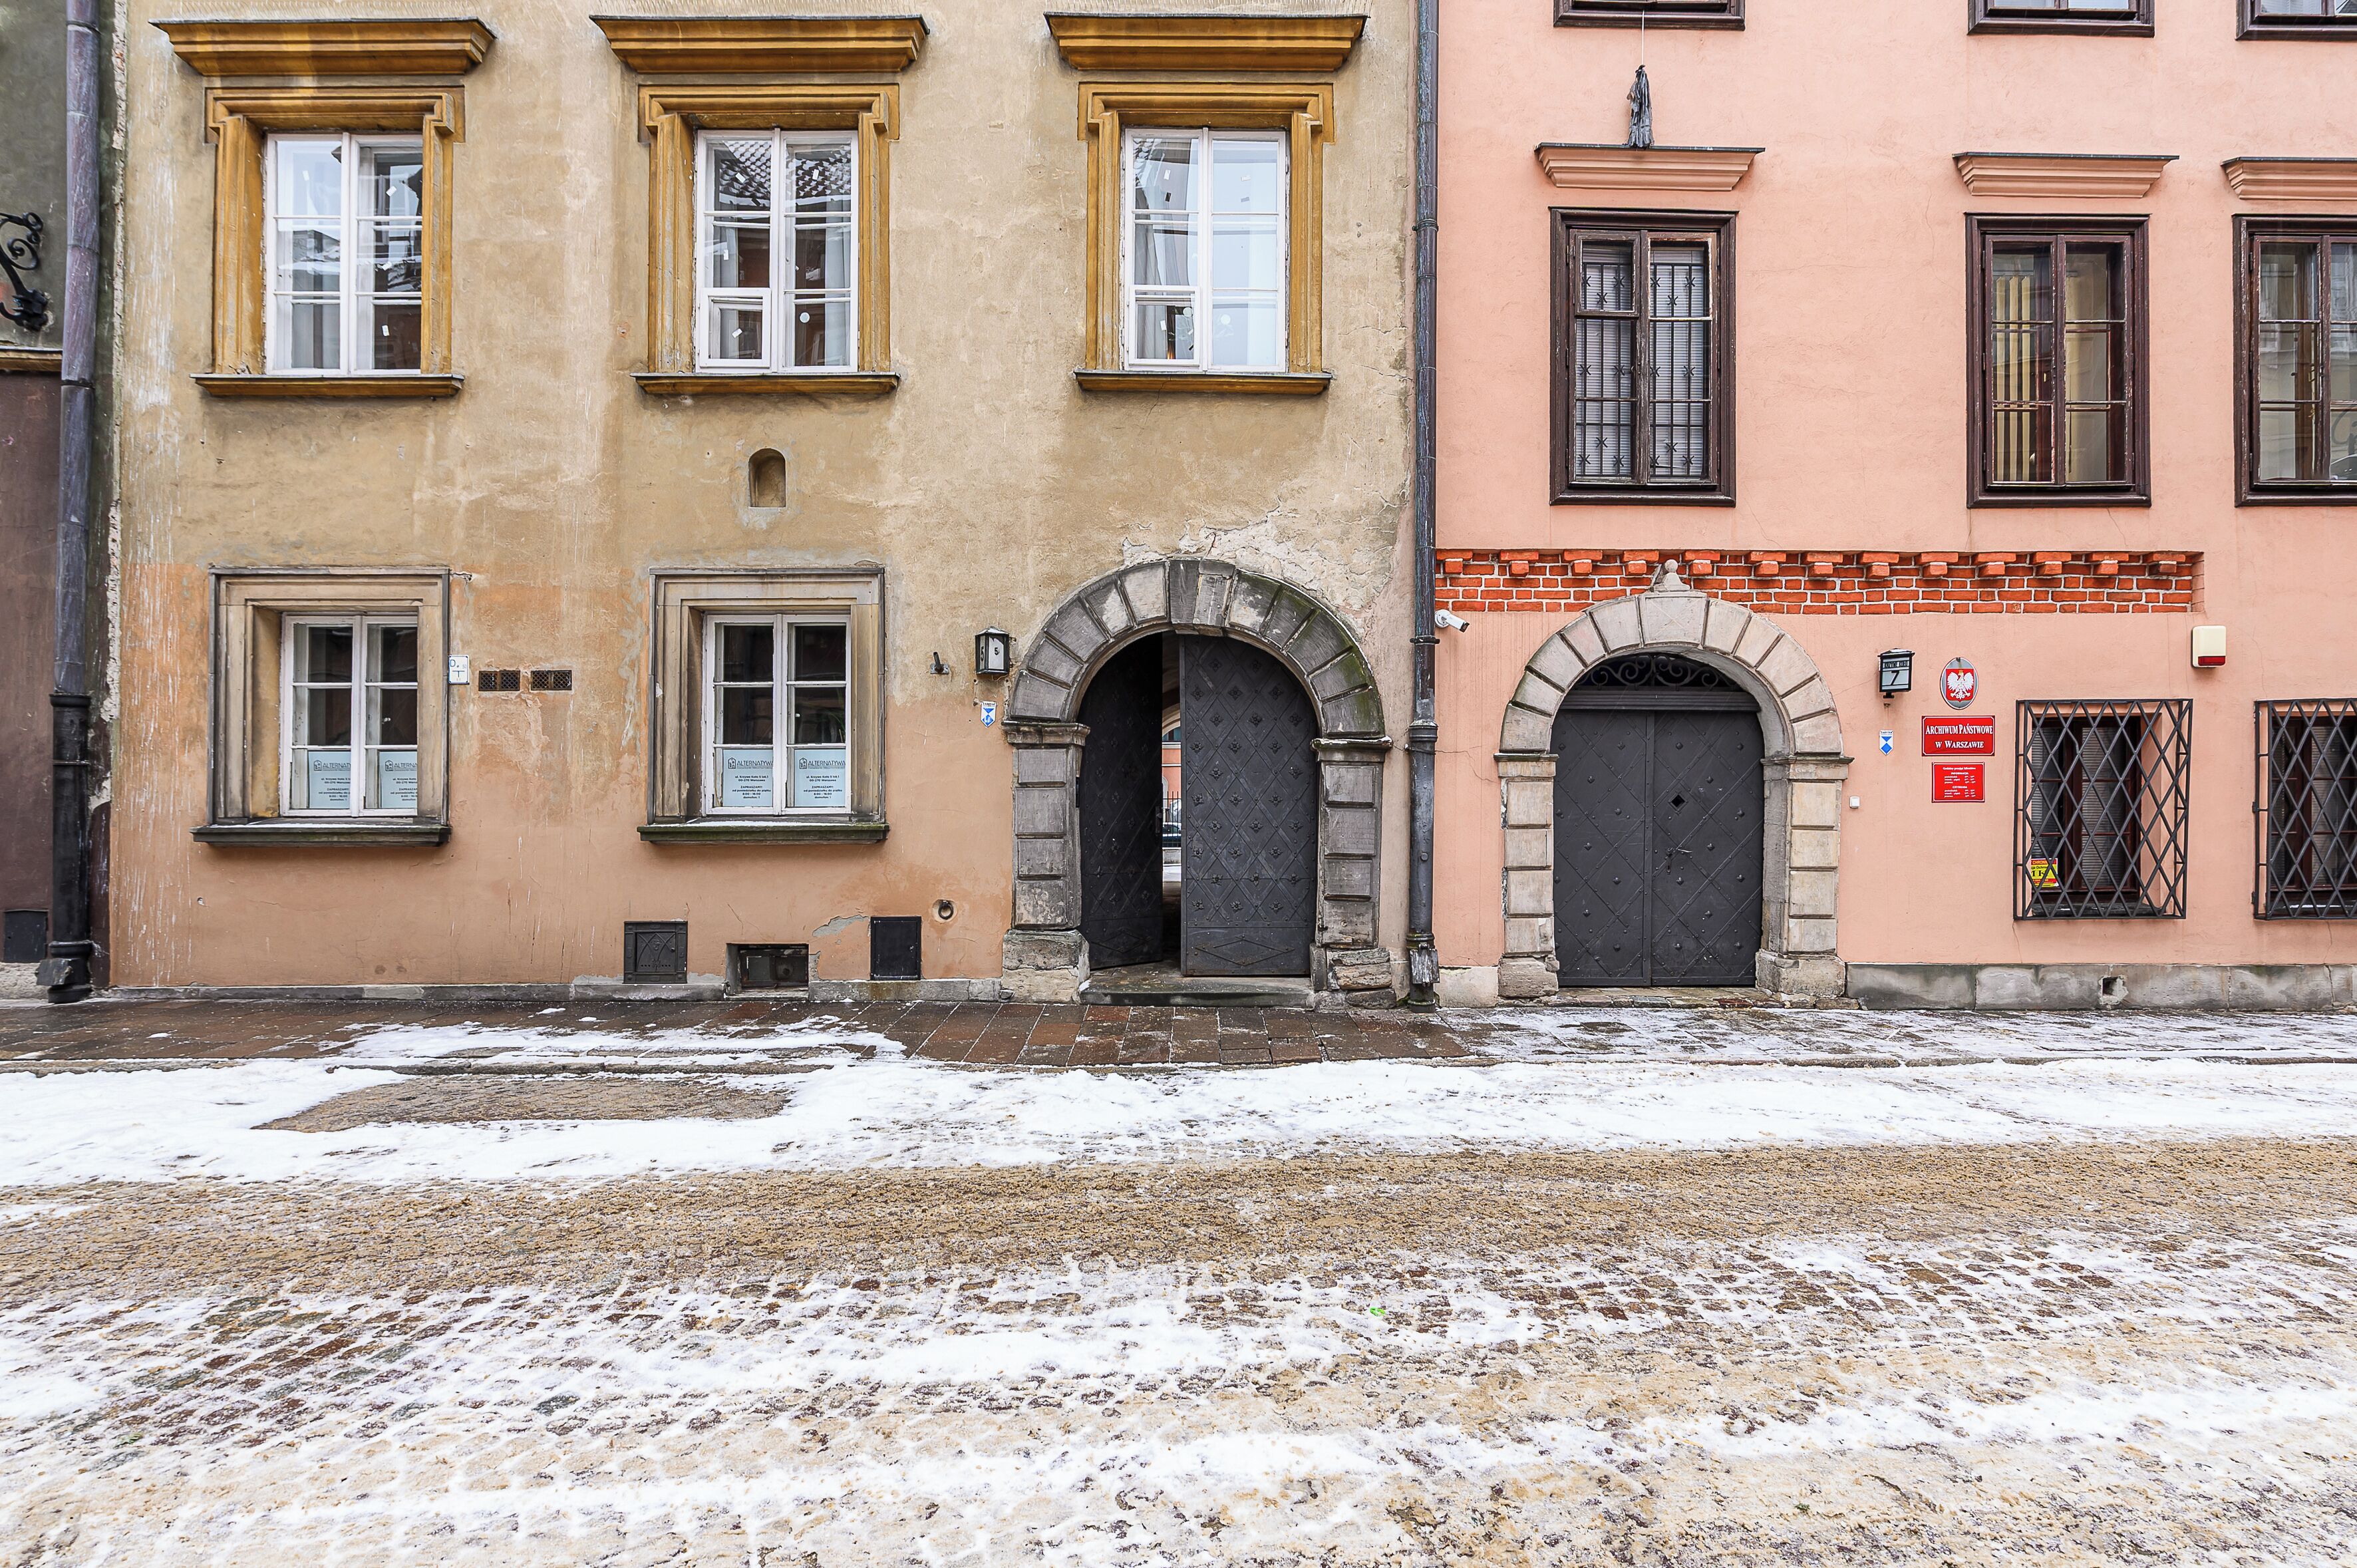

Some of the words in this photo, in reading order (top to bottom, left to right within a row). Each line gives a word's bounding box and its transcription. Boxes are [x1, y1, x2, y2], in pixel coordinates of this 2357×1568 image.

[981, 646, 985, 662] 5
[994, 647, 1000, 656] 5
[1891, 670, 1899, 685] 7
[1925, 725, 1958, 734] ARCHIWUM
[1959, 723, 1993, 734] PAŃSTWOWE
